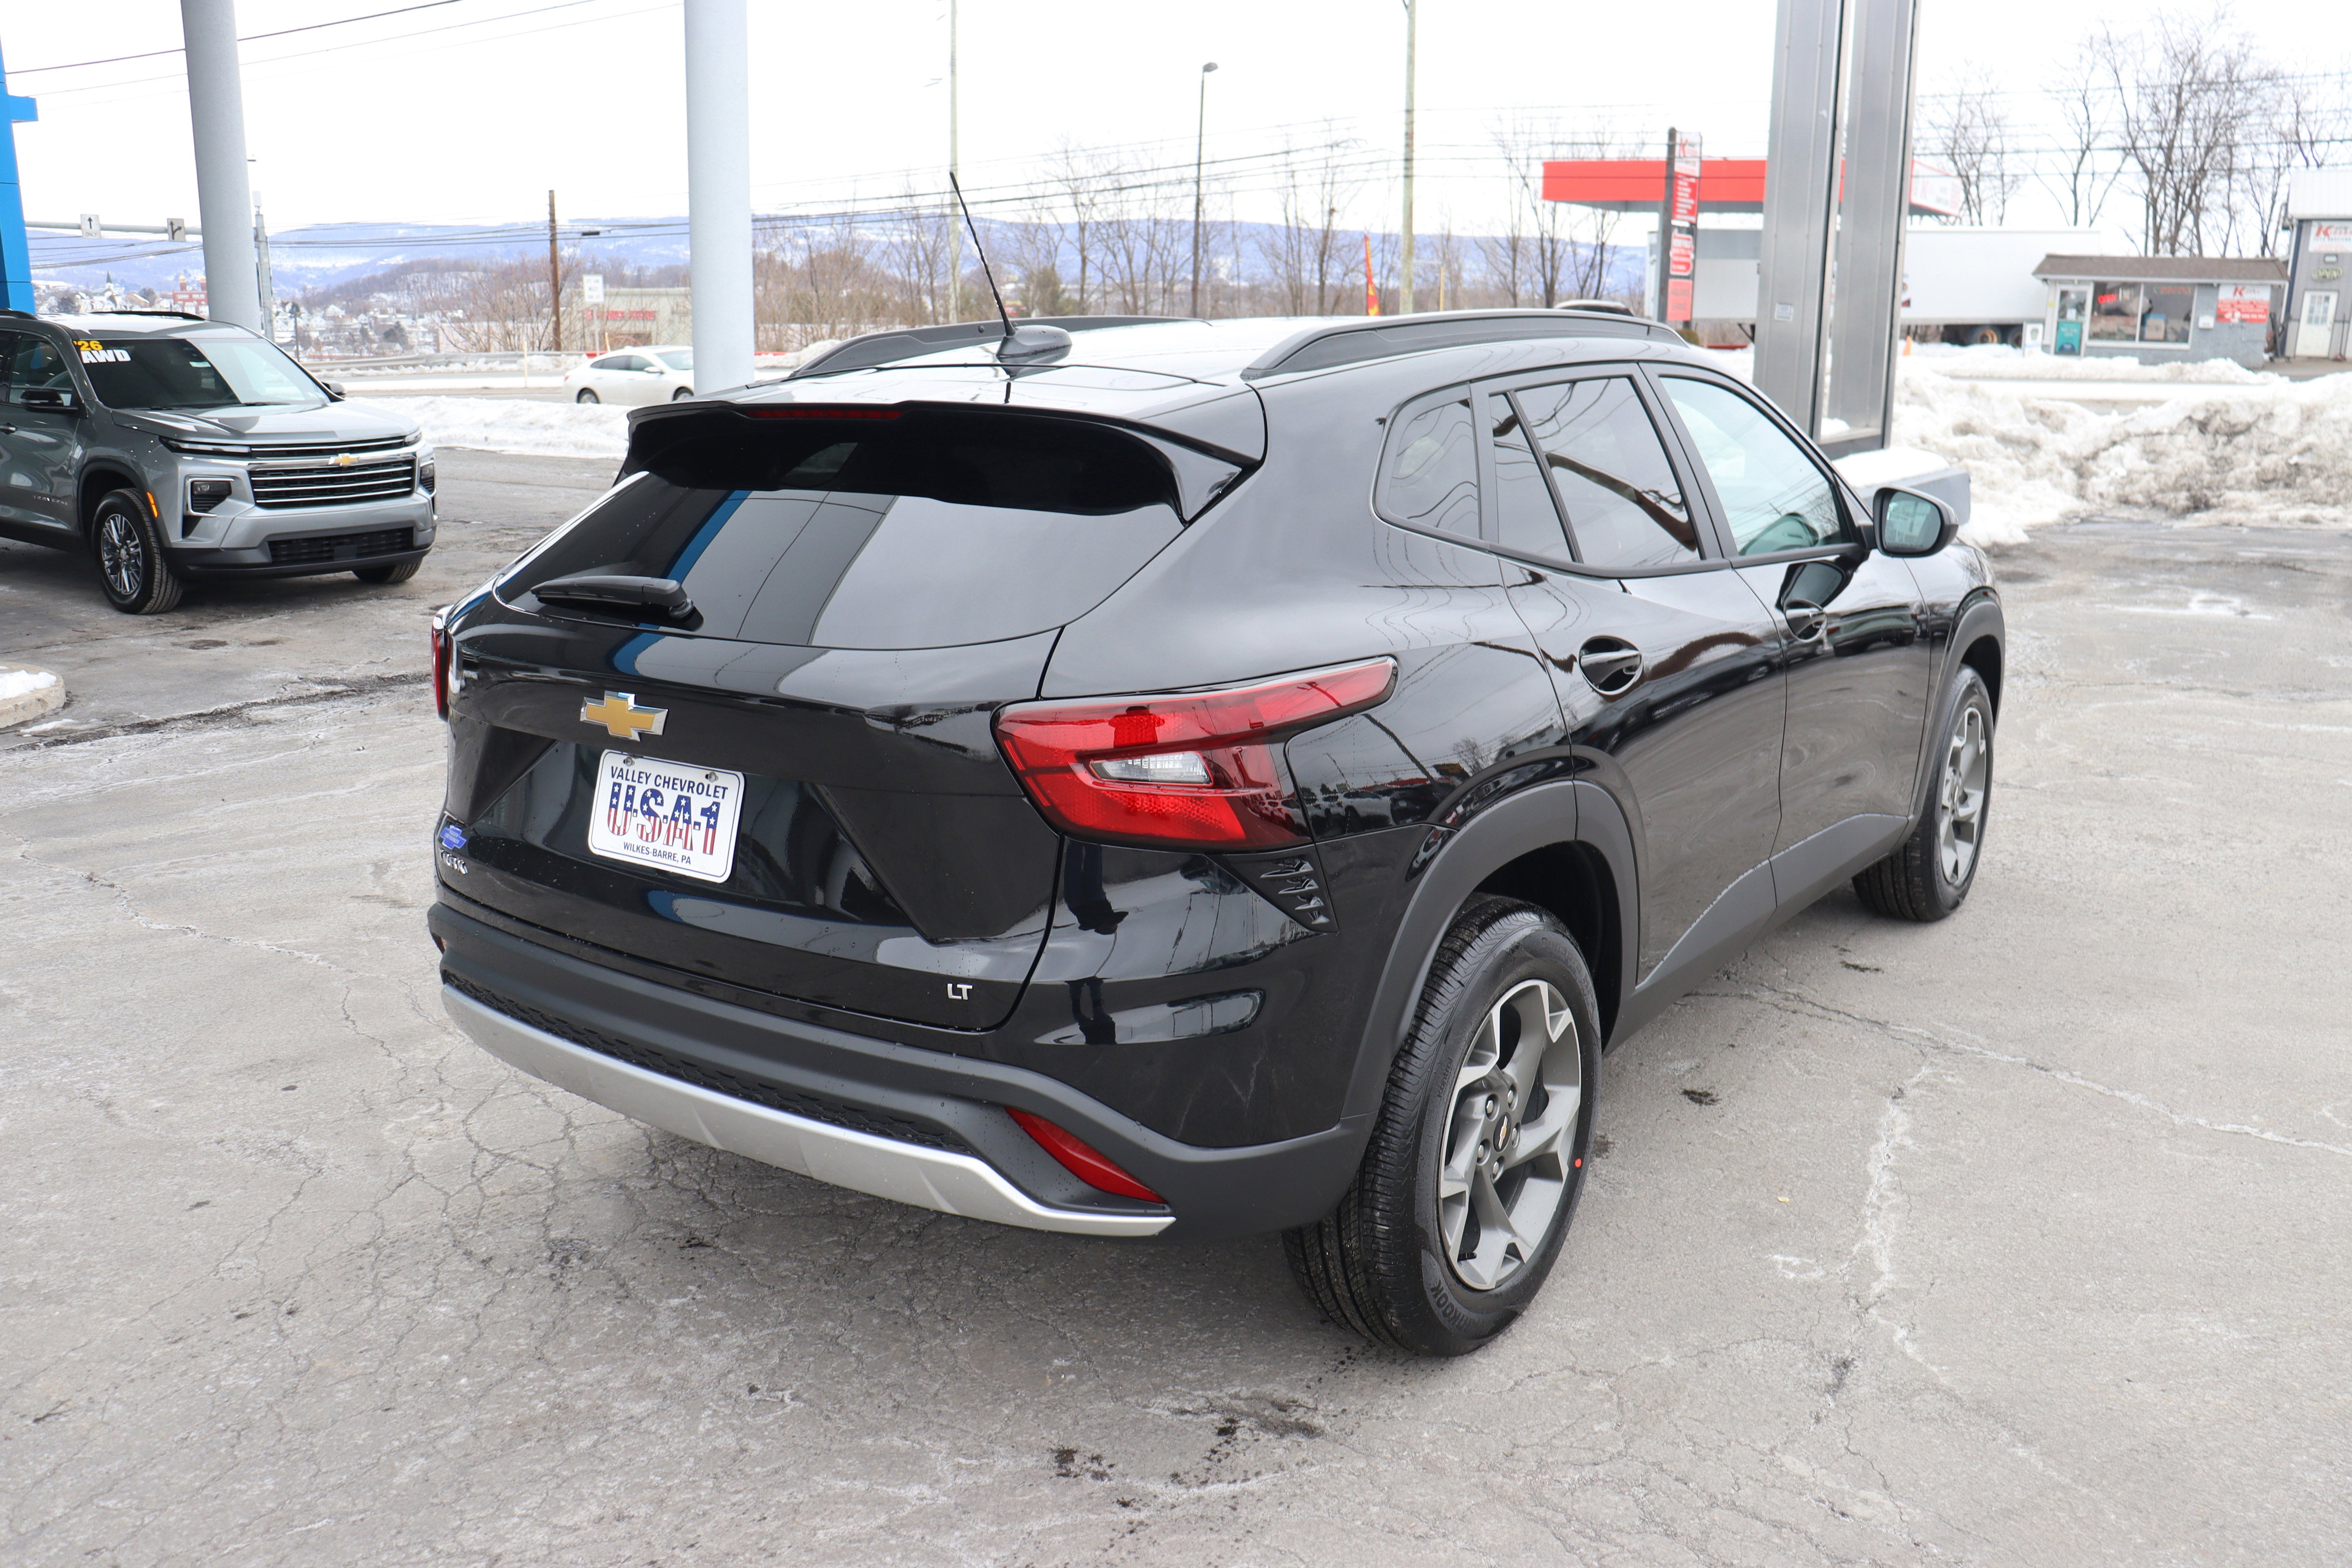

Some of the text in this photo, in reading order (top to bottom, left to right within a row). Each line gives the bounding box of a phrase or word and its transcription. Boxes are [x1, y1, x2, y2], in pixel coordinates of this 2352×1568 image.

[80, 349, 131, 363] AWD
[611, 766, 728, 800] VALLEY CHEVROLET
[623, 842, 692, 865] WILKES-BARRE, PA
[947, 983, 973, 1000] LT
